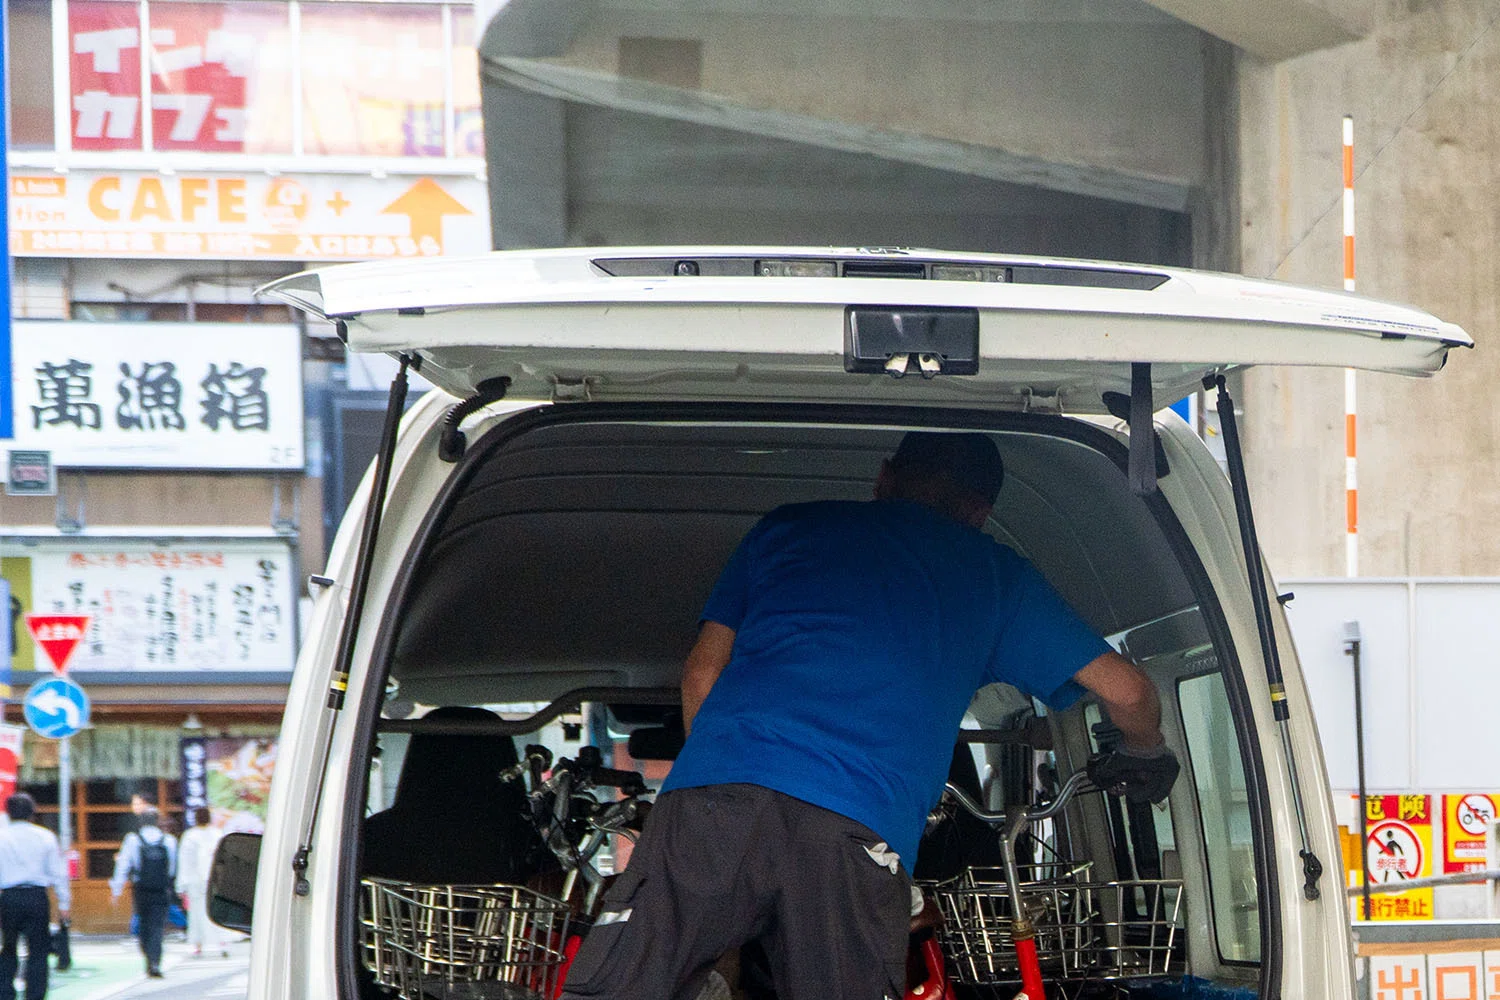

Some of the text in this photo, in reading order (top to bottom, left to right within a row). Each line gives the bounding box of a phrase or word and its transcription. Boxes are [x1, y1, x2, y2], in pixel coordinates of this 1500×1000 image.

[87, 176, 247, 223] CAFE
[31, 358, 269, 432] 萬漁箱
[1375, 858, 1409, 871] 歩行者
[1362, 898, 1429, 918] 通行禁止
